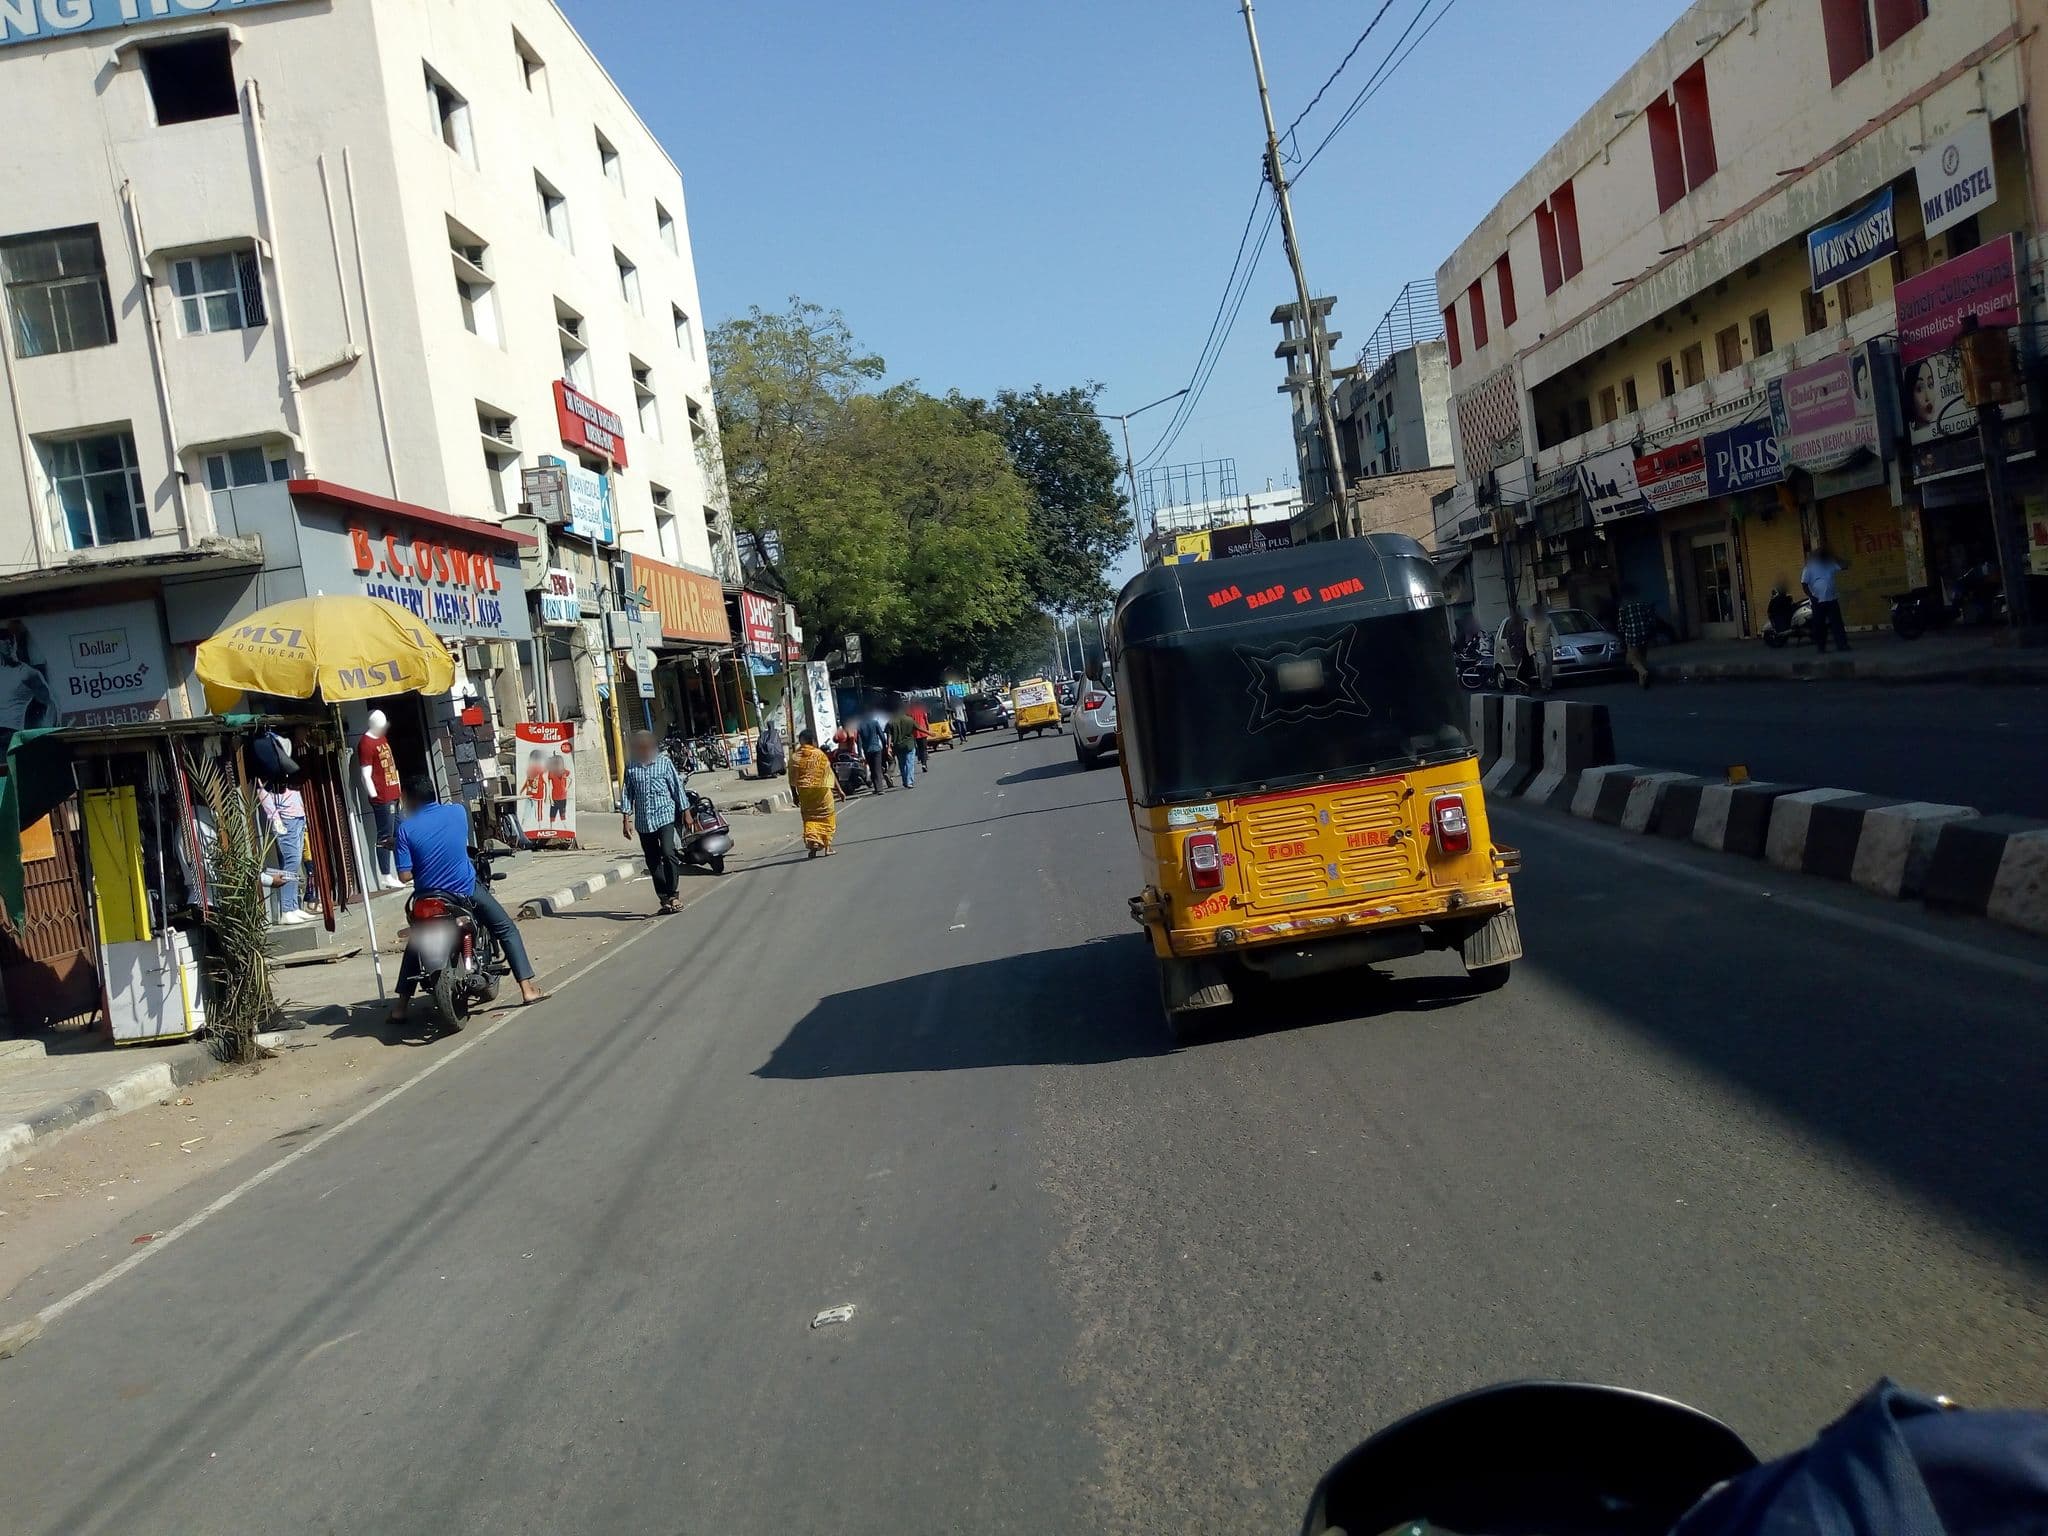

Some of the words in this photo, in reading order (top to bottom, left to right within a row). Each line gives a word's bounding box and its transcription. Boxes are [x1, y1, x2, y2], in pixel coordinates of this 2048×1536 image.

[1924, 192, 1945, 225] MK
[1946, 166, 1992, 213] HOSTEL
[1814, 240, 1831, 276] MK
[635, 566, 706, 634] KUMAR
[1208, 585, 1243, 608] MAA
[1245, 584, 1287, 609] BAAP
[1292, 586, 1312, 604] KI
[1319, 577, 1365, 603] DUWA
[478, 597, 502, 624] KIDS
[79, 640, 119, 657] Dollar
[227, 641, 306, 661] FOOTWEAR
[232, 625, 308, 650] MSL
[69, 670, 144, 699] Bigboss
[338, 660, 411, 690] MSL
[105, 708, 127, 726] Hai
[130, 707, 161, 723] Boss
[1268, 842, 1307, 859] FOR
[1347, 830, 1391, 848] HIRE
[1191, 895, 1231, 921] STOP
